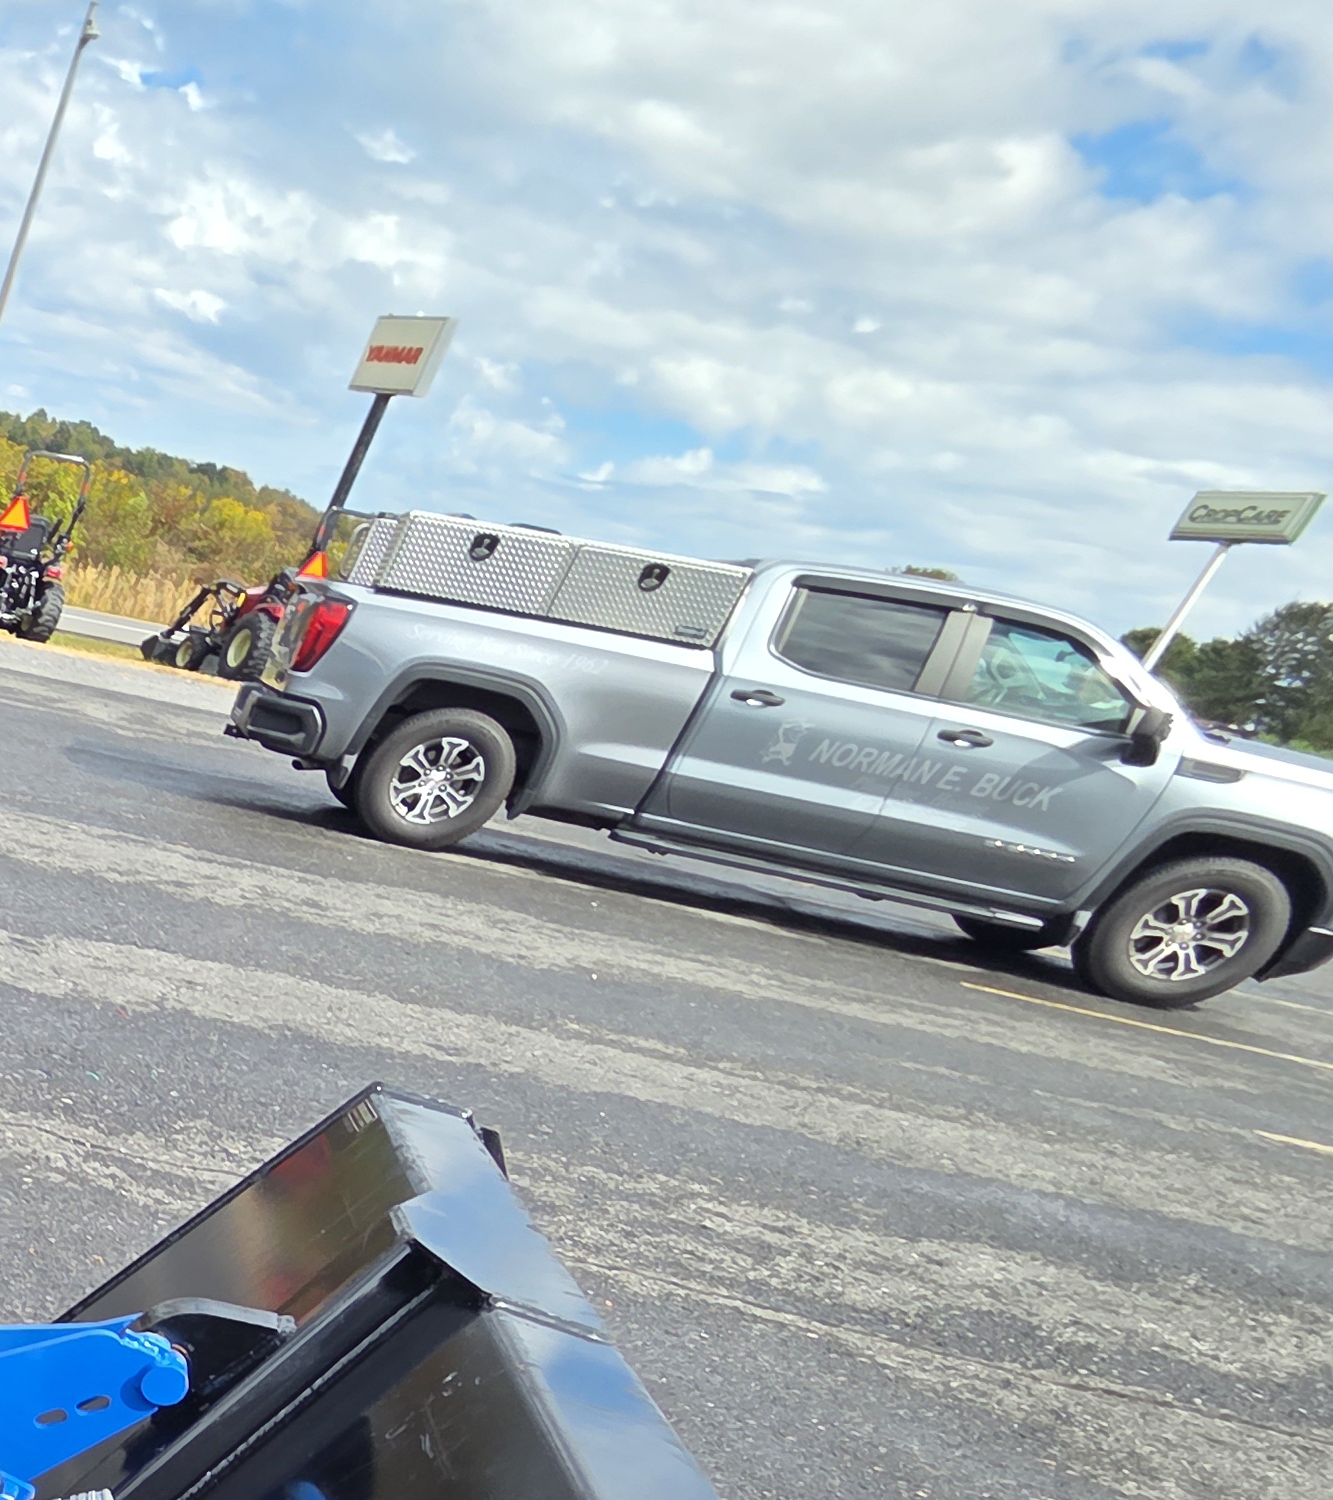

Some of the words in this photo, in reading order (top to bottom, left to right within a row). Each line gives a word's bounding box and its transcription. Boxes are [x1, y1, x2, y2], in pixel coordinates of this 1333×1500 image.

[808, 739, 942, 785] NORMAN
[935, 765, 968, 792] E.
[970, 772, 1064, 811] BUCK
